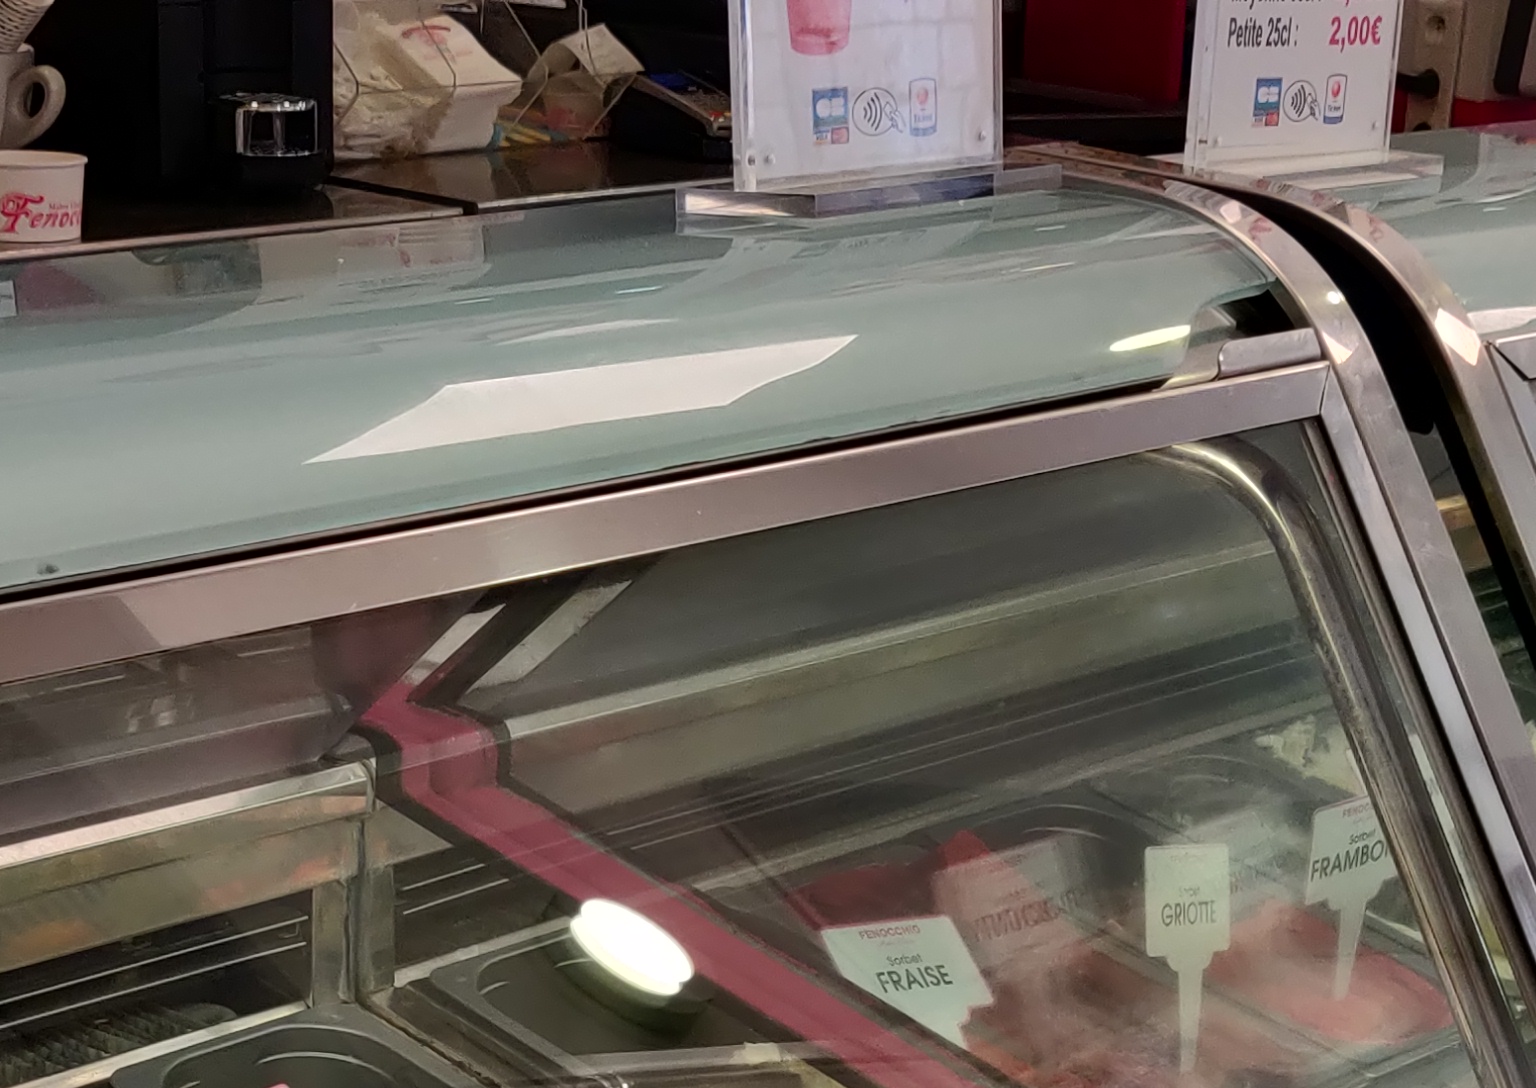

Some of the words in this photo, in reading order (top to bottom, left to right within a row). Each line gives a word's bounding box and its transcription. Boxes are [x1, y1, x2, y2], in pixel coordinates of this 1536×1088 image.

[1227, 17, 1263, 48] Petite
[1265, 16, 1292, 48] 25cl
[1329, 15, 1383, 53] 2,00€
[1161, 900, 1217, 928] GRIOTTE
[875, 964, 954, 994] FRAISE
